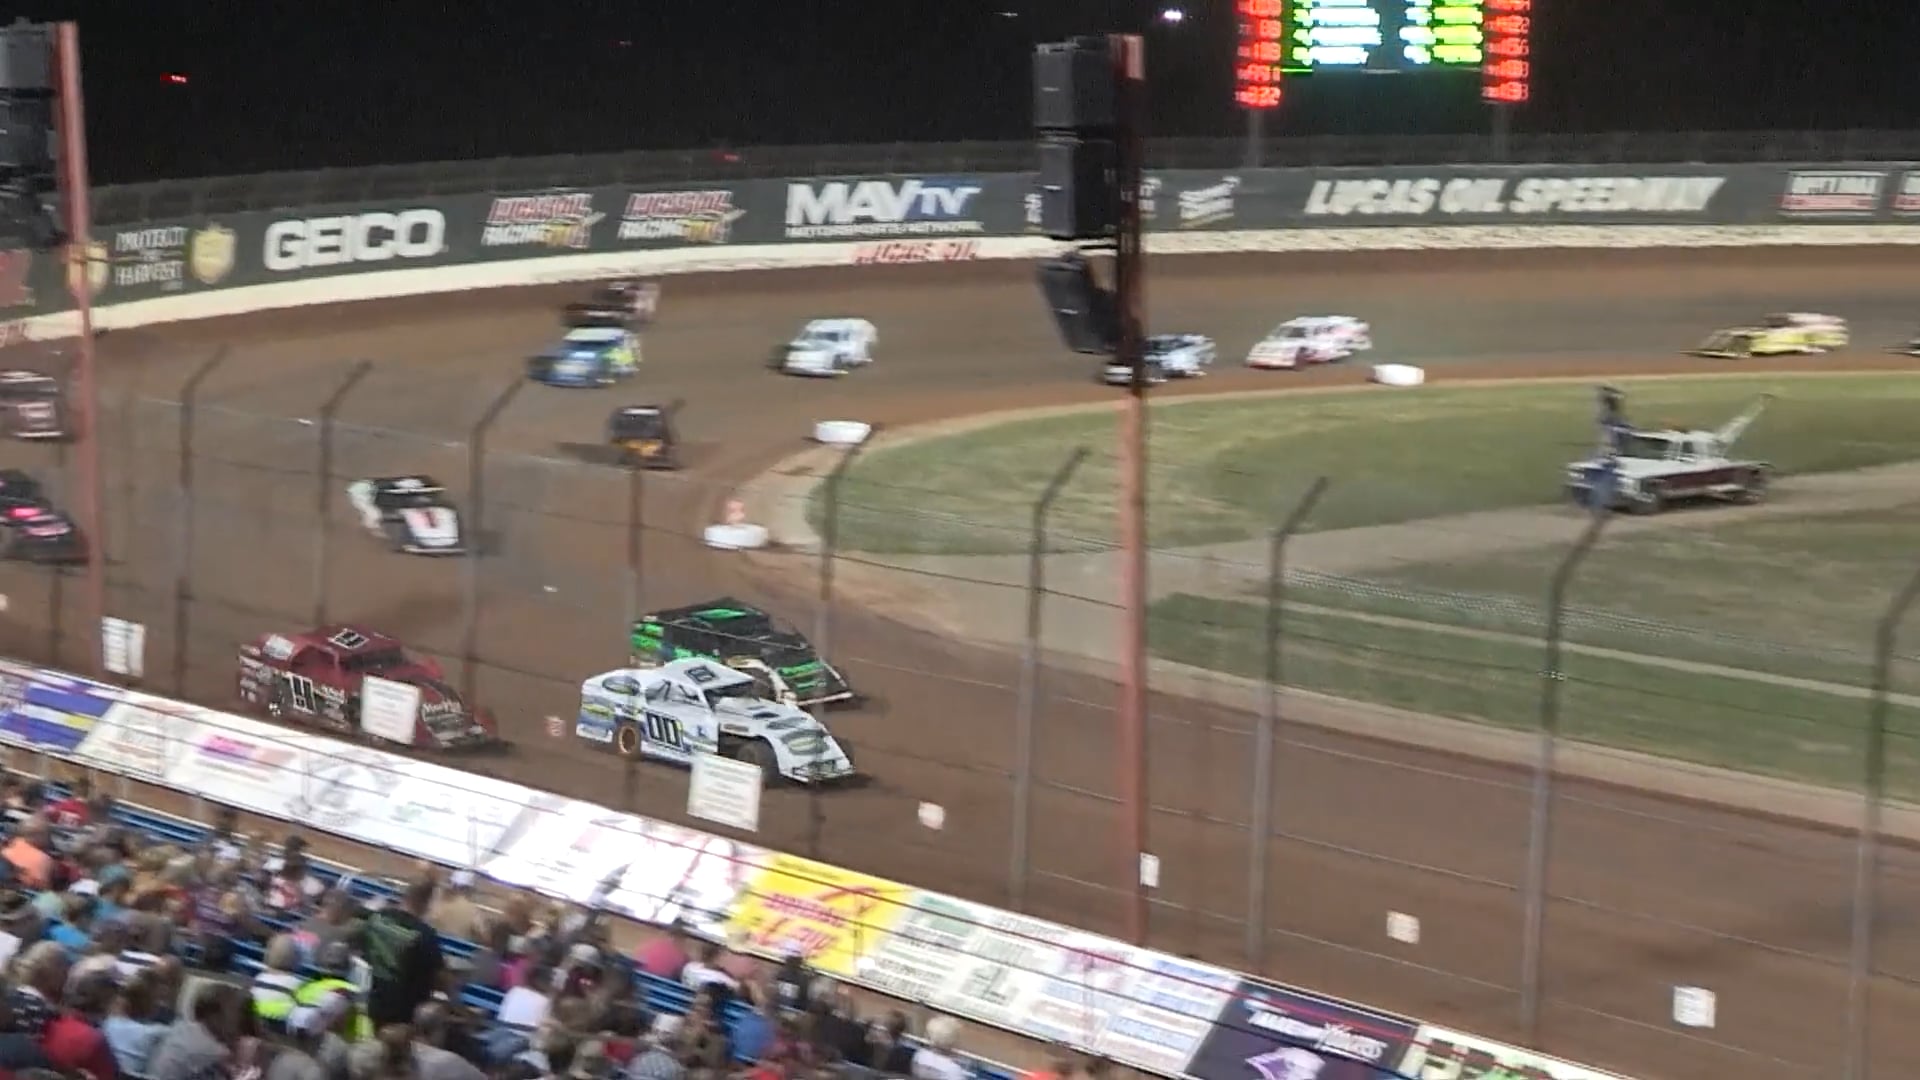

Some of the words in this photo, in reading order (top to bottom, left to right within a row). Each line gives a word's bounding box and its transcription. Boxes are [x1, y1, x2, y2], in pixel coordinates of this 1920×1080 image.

[786, 180, 982, 224] MAVTV
[1304, 179, 1441, 215] LUCAS
[1440, 178, 1507, 213] OIL
[1509, 177, 1726, 213] SPEEDWAY
[263, 209, 445, 271] GEICO
[646, 711, 683, 749] 00
